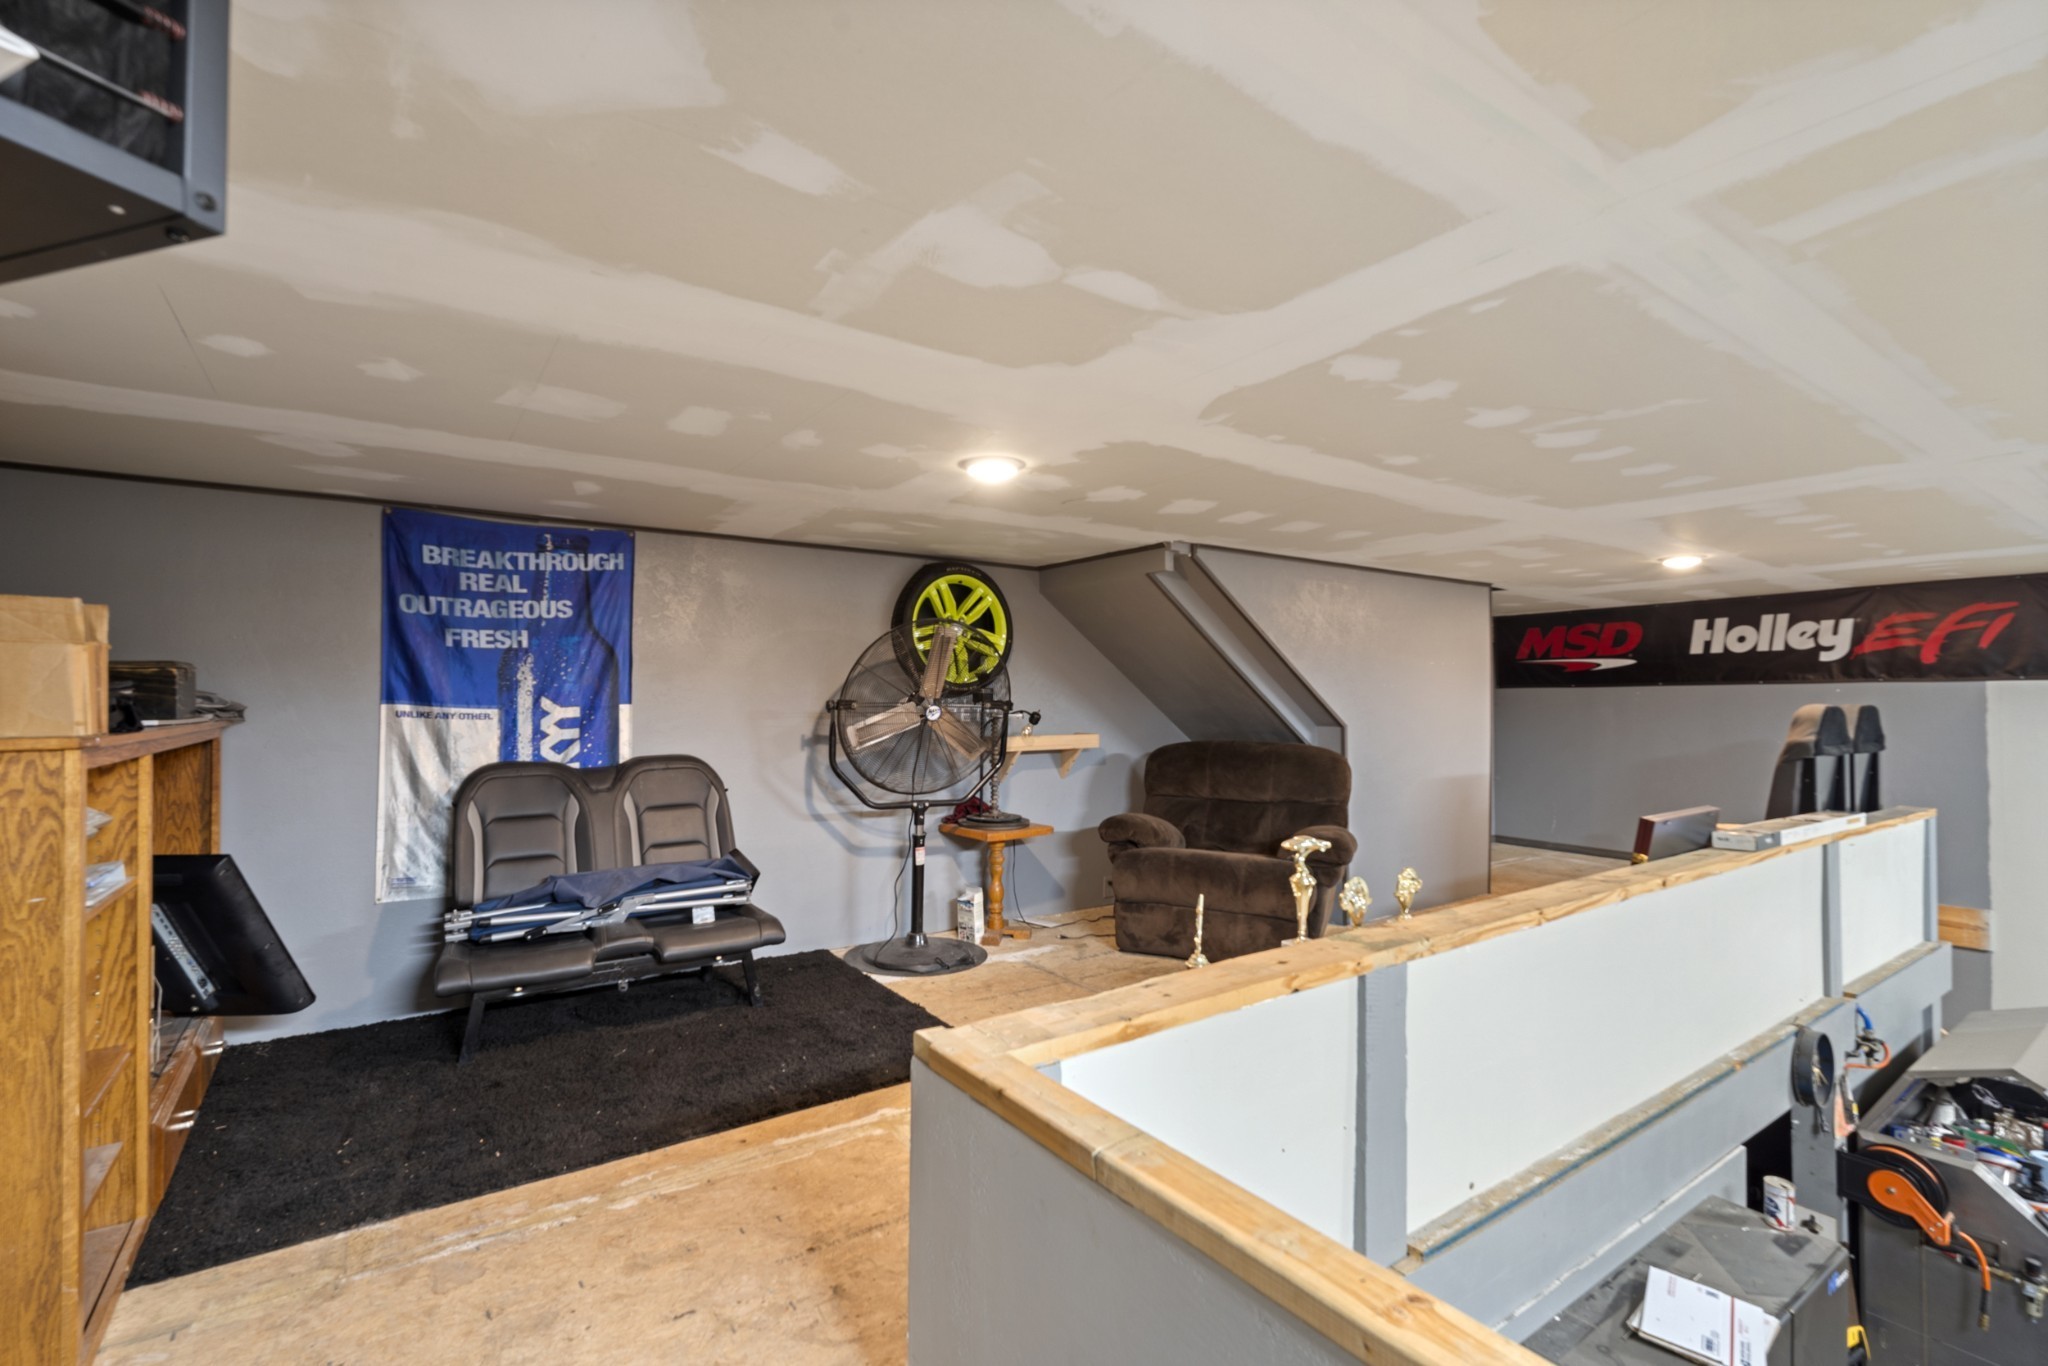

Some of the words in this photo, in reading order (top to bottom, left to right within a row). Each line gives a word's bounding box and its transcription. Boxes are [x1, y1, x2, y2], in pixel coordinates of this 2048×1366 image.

[422, 544, 624, 571] BREAKTHROUGH
[459, 572, 528, 593] REAL
[399, 594, 573, 618] OUTRAGEOUS
[445, 628, 529, 648] FRESH
[1515, 621, 1643, 659] MSD
[1689, 613, 1855, 662] Holley
[1850, 601, 2019, 664] EFI
[395, 710, 432, 719] UNLIKE
[435, 711, 457, 720] ANY
[458, 712, 493, 720] OTHER.
